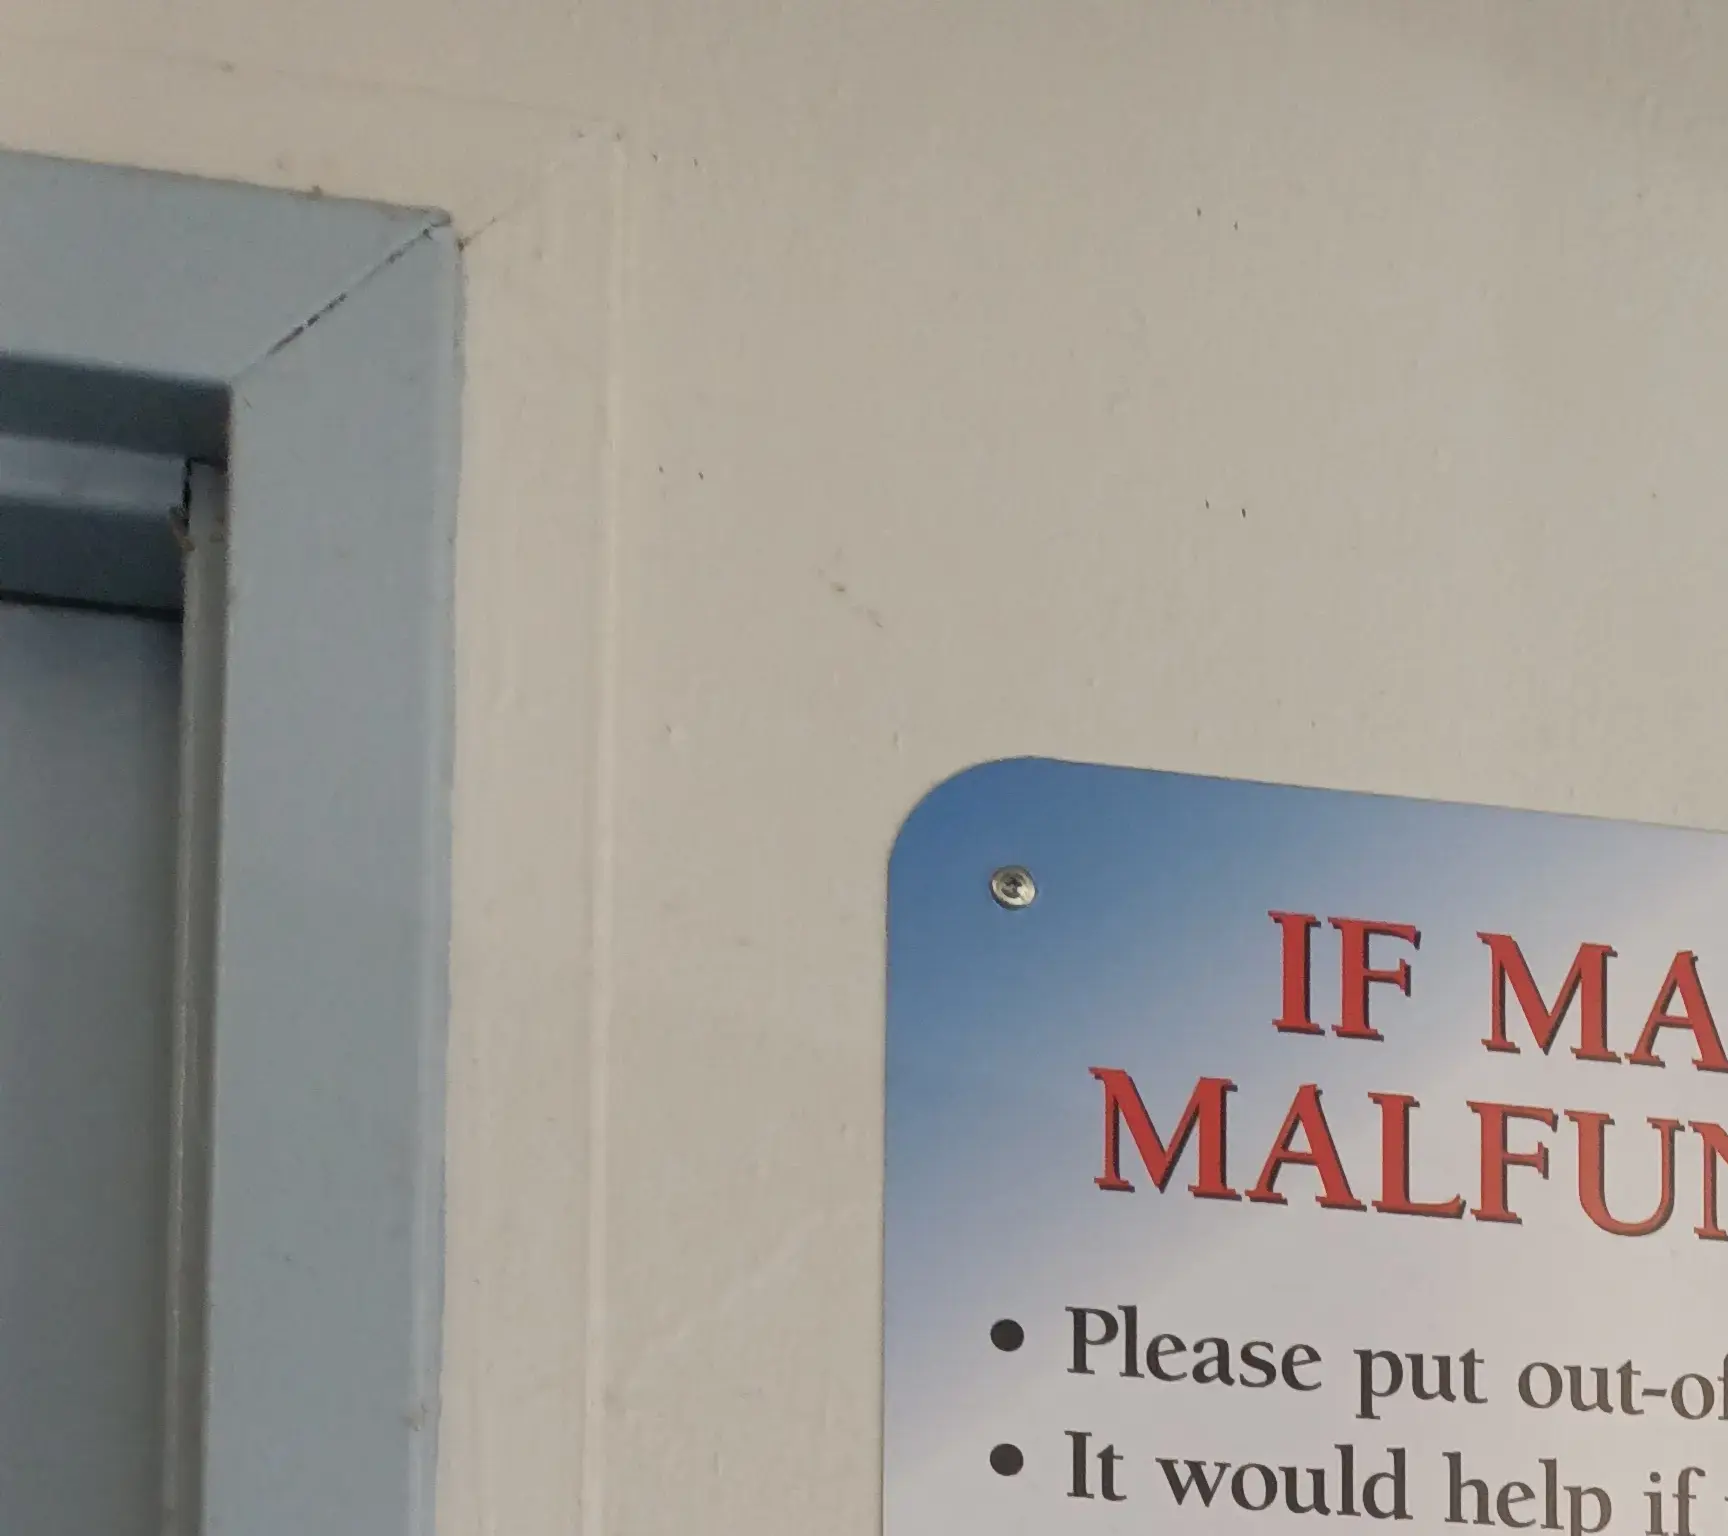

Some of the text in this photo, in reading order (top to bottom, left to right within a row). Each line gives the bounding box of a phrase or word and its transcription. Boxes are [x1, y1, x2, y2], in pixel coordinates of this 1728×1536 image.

[1268, 911, 1421, 1042] IF
[1065, 1305, 1321, 1391] Please
[1353, 1348, 1488, 1420] put
[1064, 1431, 1127, 1501] It
[1155, 1444, 1413, 1520] would
